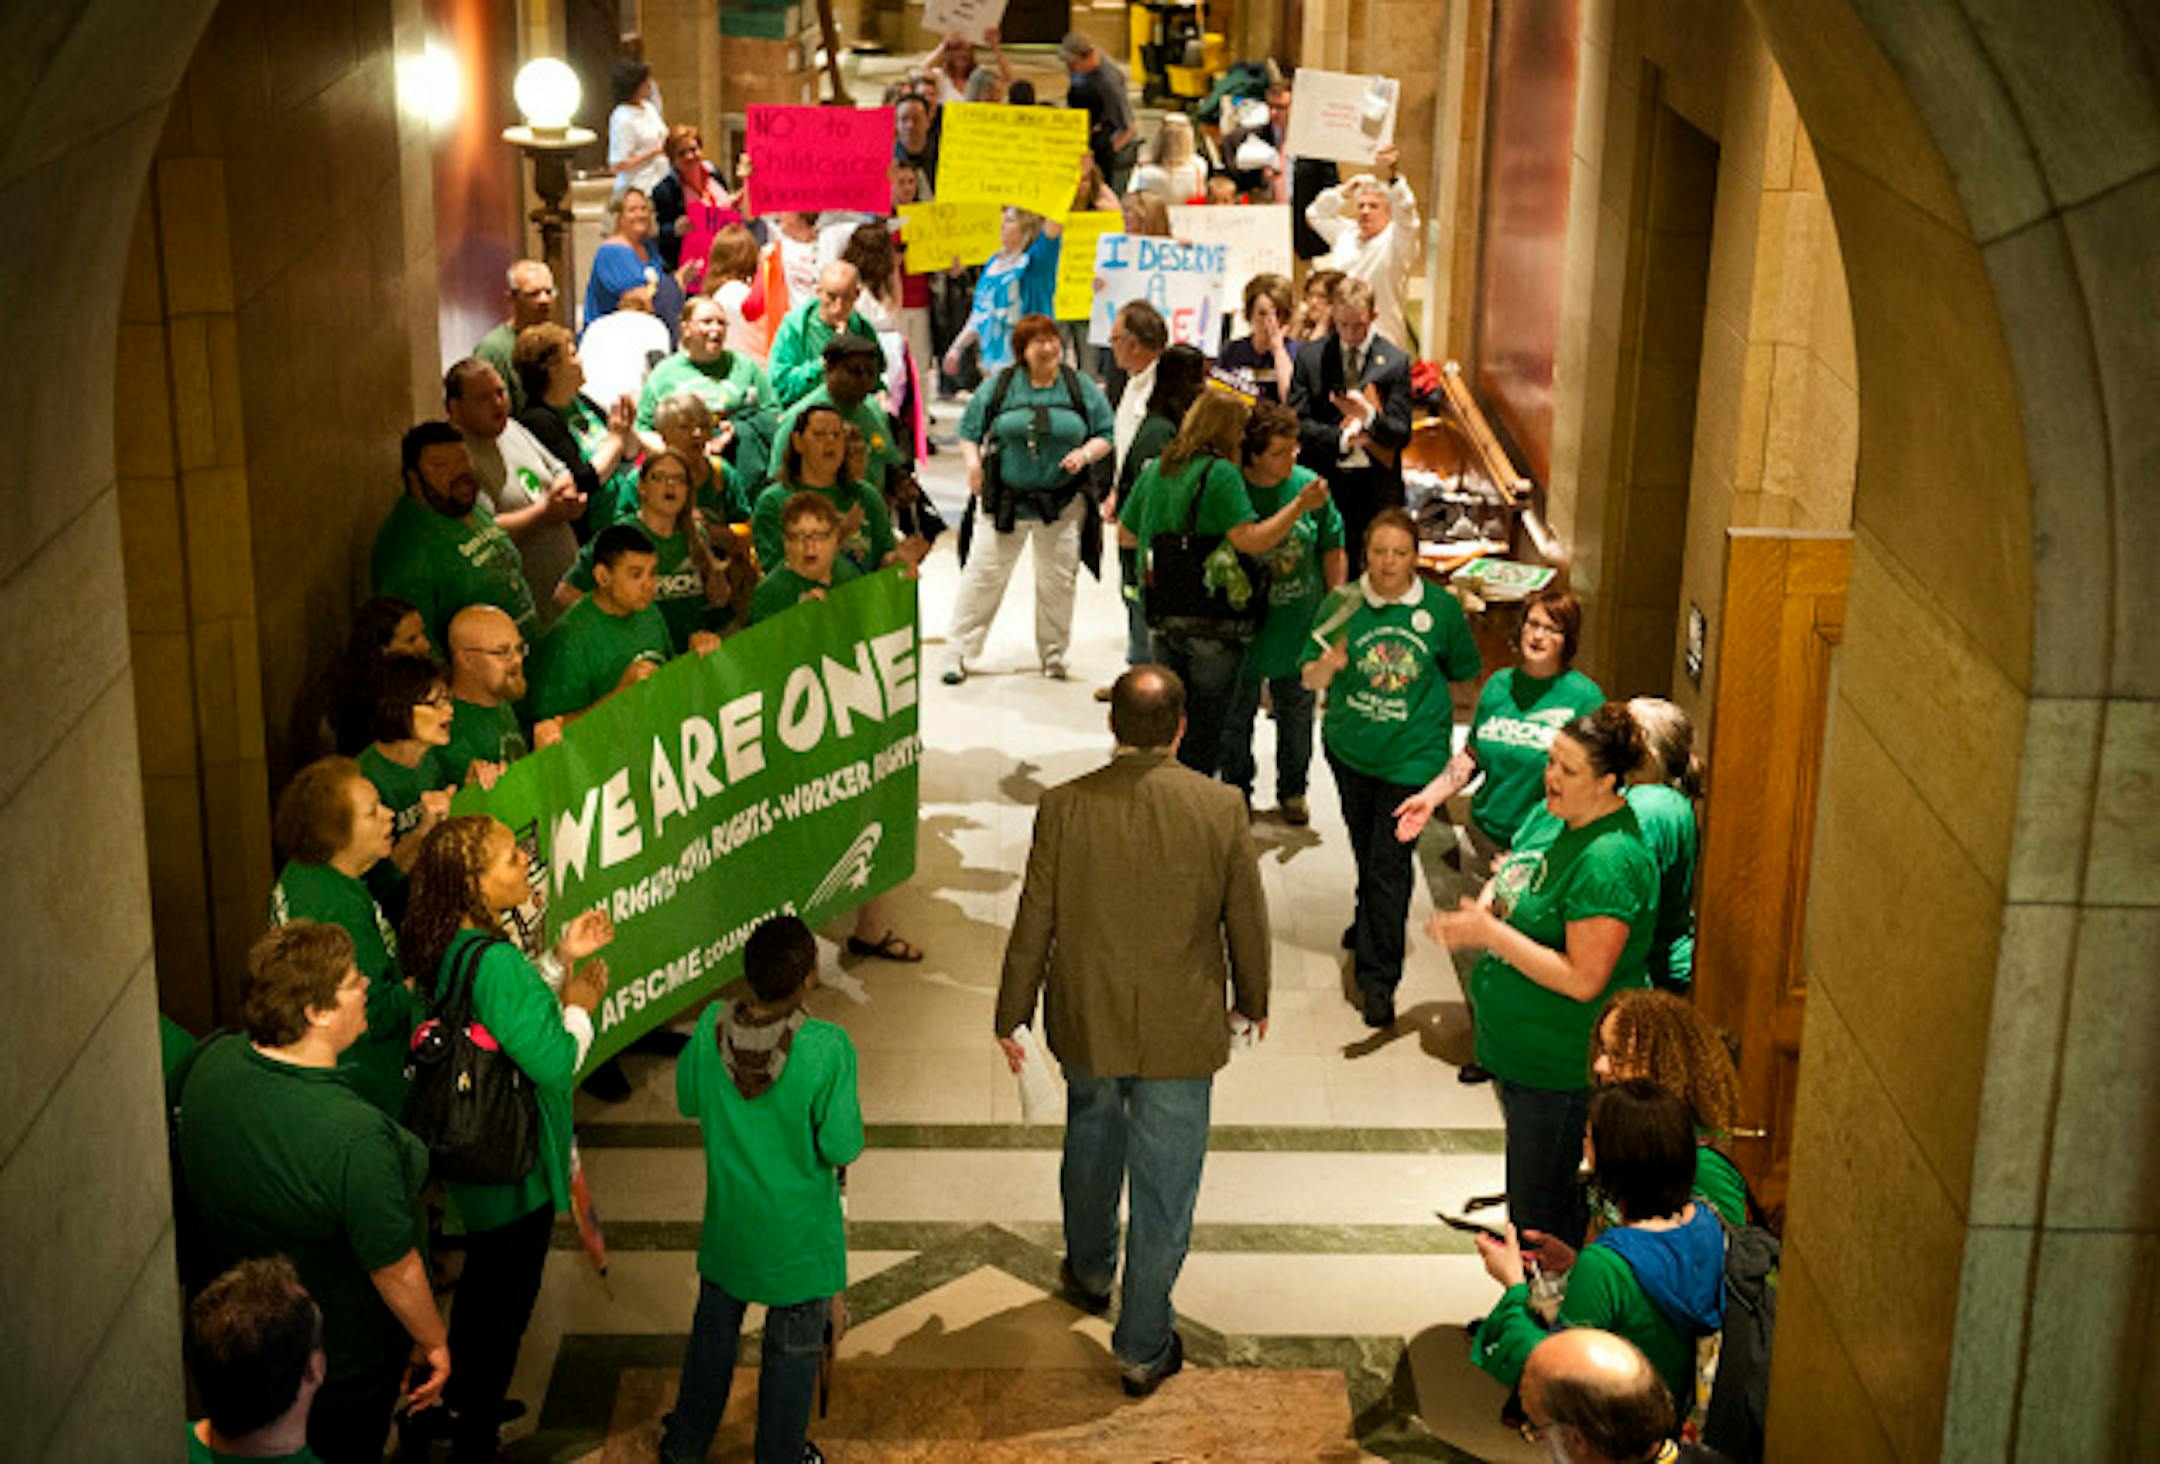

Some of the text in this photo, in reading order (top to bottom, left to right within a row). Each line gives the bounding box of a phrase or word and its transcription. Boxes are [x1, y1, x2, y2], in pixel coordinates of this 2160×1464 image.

[754, 111, 852, 141] NO to
[1101, 235, 1129, 269] I
[1137, 240, 1227, 274] DESERVE
[1146, 272, 1168, 312] A
[553, 624, 917, 898] WE ARE ONE
[711, 798, 773, 859] RIGHTS
[779, 760, 873, 821] WORKER
[601, 945, 704, 1033] AFSCME
